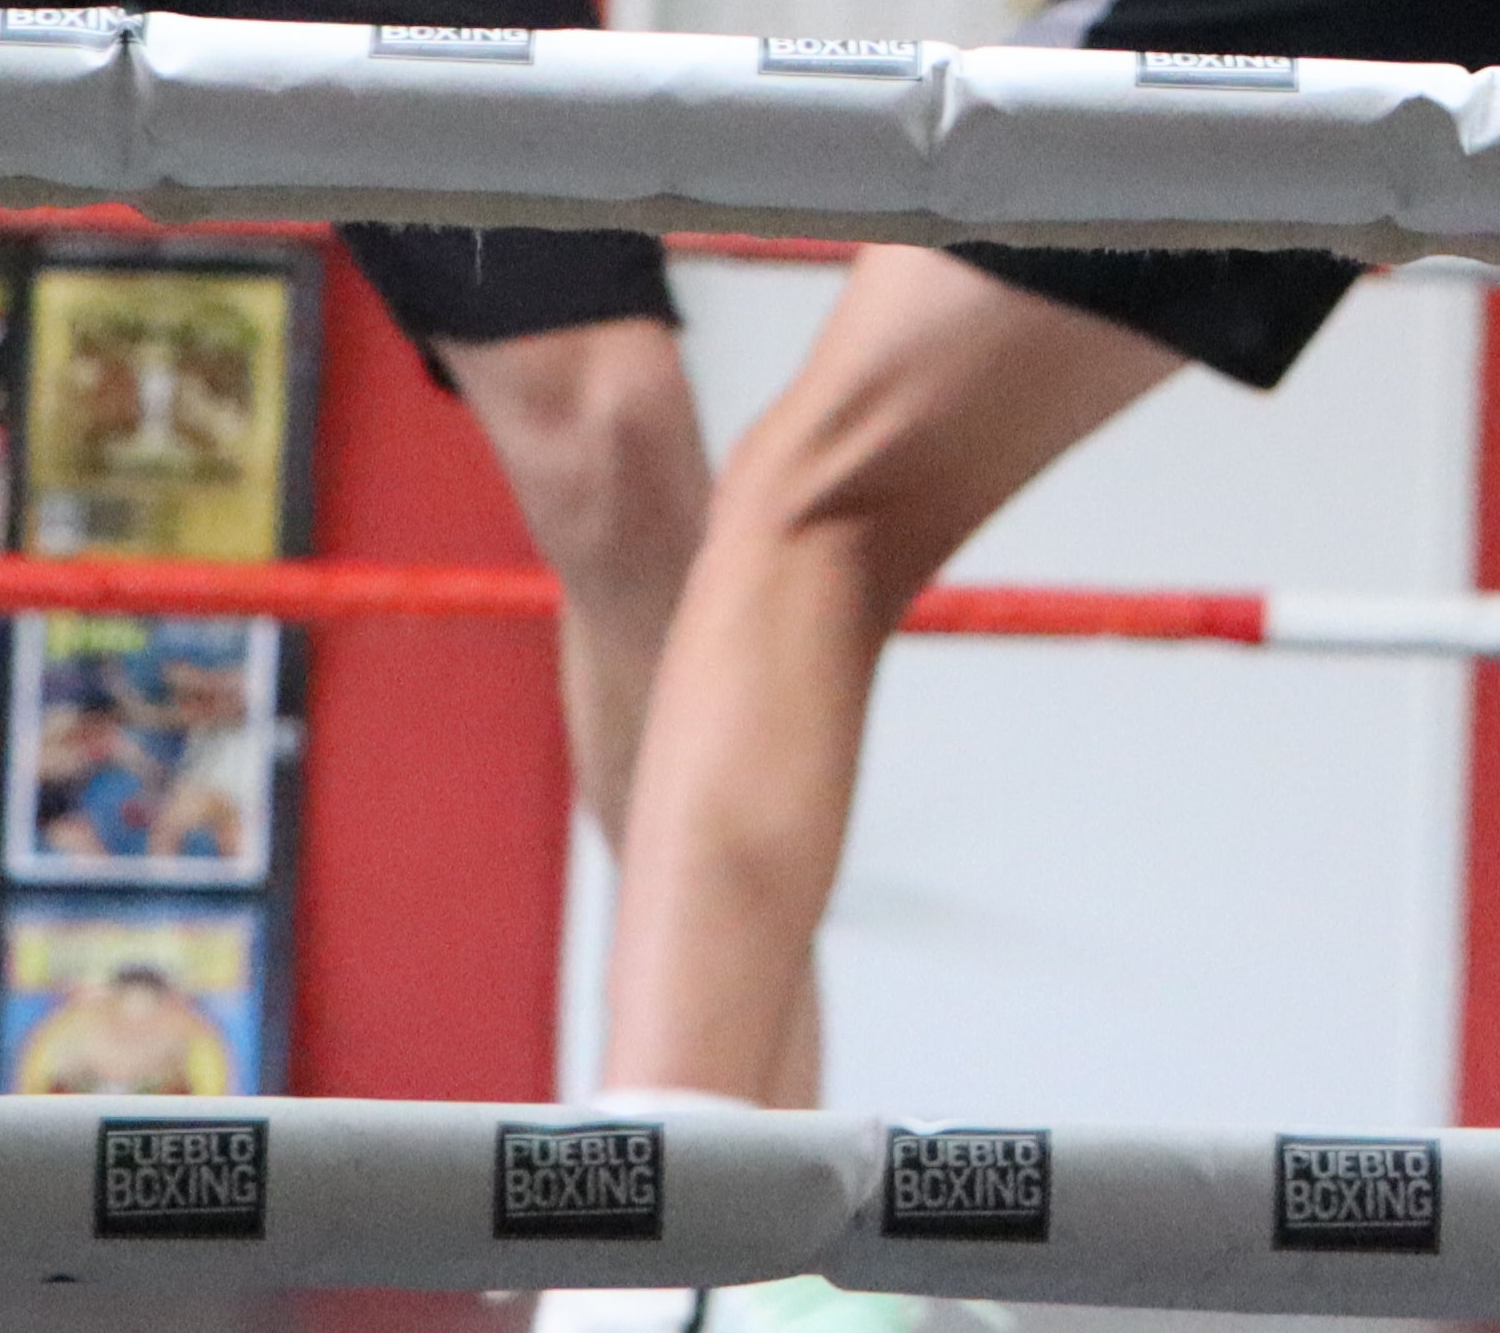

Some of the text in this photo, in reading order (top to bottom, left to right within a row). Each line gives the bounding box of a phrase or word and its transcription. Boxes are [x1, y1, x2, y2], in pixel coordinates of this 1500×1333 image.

[381, 25, 530, 42] BOXING
[767, 38, 912, 55] BOXING
[1142, 52, 1290, 69] BOXING
[107, 1134, 256, 1165] PUEBLO
[505, 1136, 652, 1168] PUEBLO
[893, 1139, 1040, 1168] PUEBLO
[1285, 1150, 1429, 1180] PUEBLO
[108, 1165, 257, 1209] BOXING
[506, 1167, 655, 1210] BOXING
[897, 1168, 1043, 1210] BOXING
[1286, 1178, 1433, 1221] BOXING
